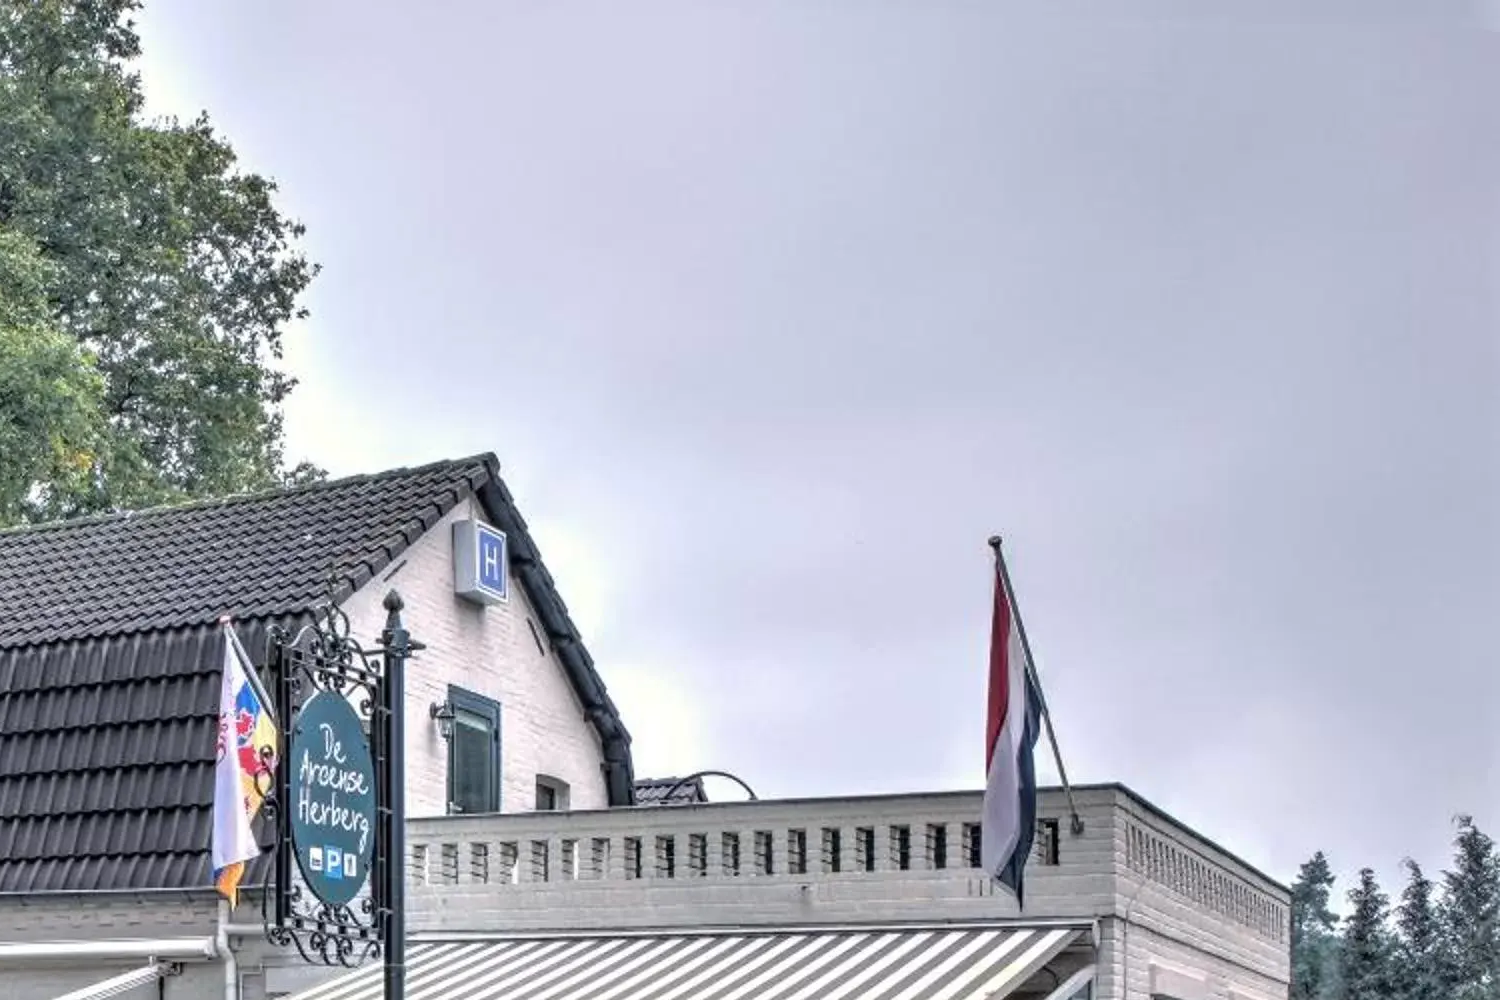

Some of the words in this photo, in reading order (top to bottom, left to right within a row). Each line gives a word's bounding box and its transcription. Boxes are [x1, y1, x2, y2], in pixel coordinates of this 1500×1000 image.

[484, 543, 499, 580] H
[319, 722, 347, 764] De
[299, 747, 370, 796] Arcense
[298, 785, 370, 856] Herberg
[326, 849, 342, 874] P
